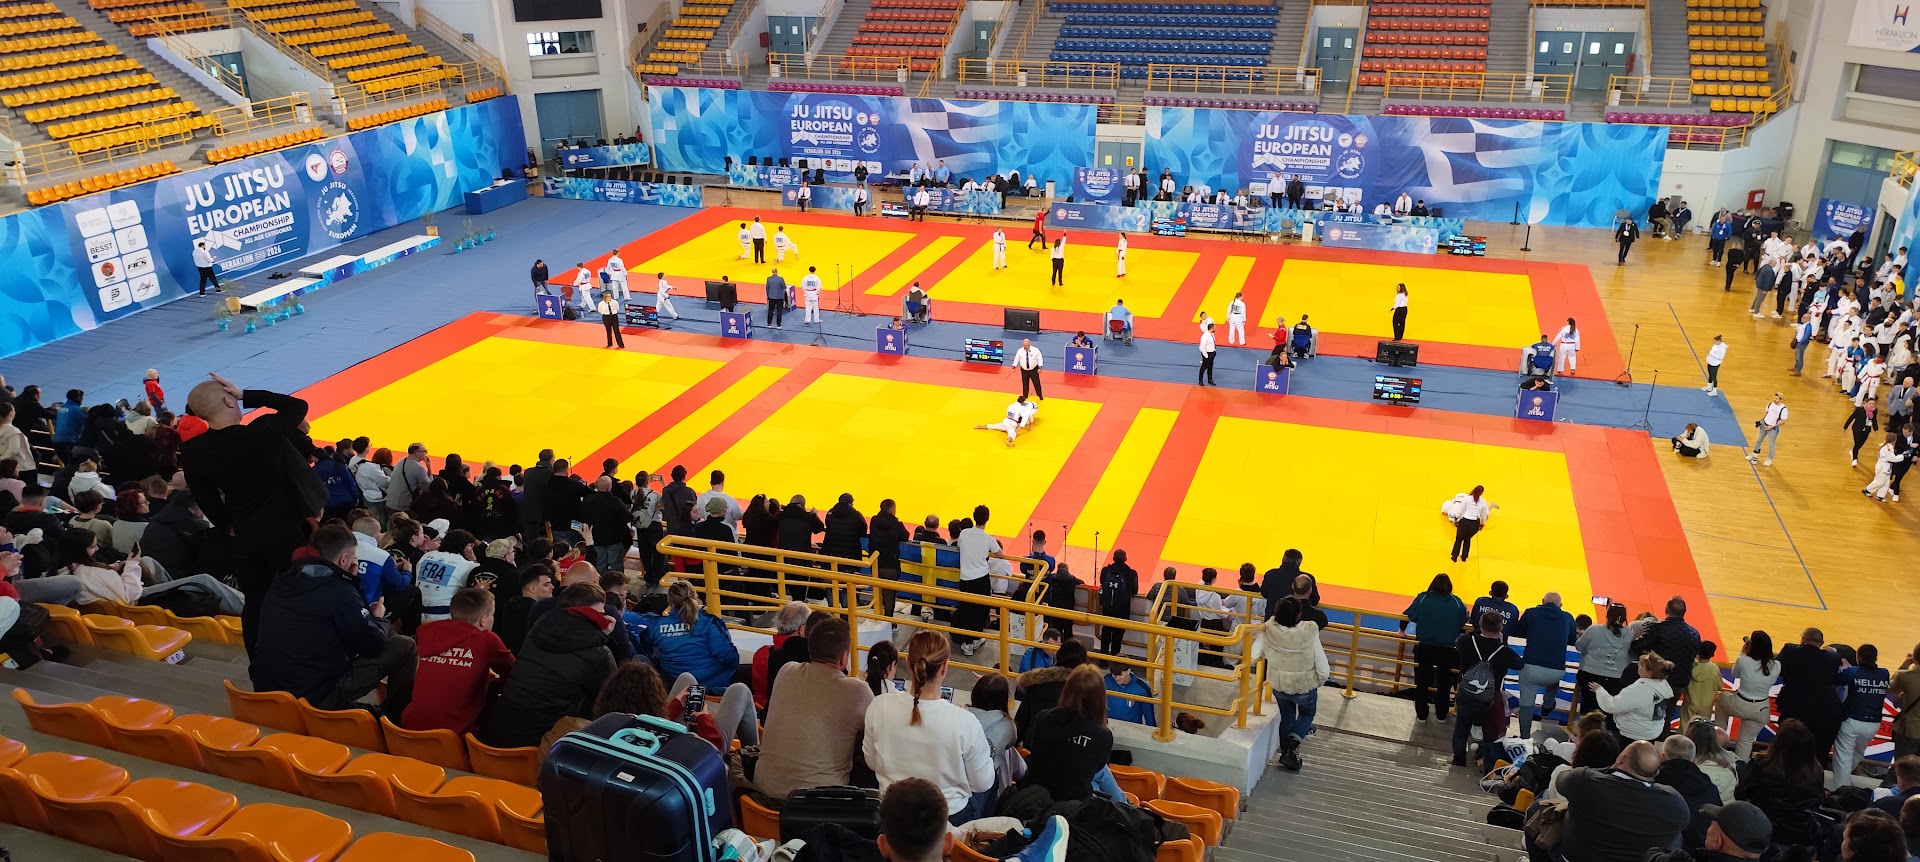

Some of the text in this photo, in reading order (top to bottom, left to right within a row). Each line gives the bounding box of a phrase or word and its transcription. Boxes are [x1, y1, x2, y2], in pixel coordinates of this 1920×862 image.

[791, 105, 852, 120] JU JITSU
[791, 120, 852, 132] EUROPEAN
[1256, 124, 1334, 142] JU JITSU
[1254, 141, 1332, 156] EUROPEAN
[185, 164, 284, 211] JU JITSU
[321, 181, 347, 195] JU JITSU
[187, 191, 291, 235] EUROPEAN
[1845, 207, 1863, 215] JITSU
[233, 216, 290, 238] CHAMPIONSHIP
[1137, 214, 1146, 226] 2
[265, 226, 293, 239] CATEGORIES
[328, 223, 358, 239] EUROPEAN
[1422, 235, 1432, 248] 3
[90, 243, 113, 255] BESST
[220, 245, 282, 271] HERAKLION 2026
[421, 562, 446, 580] FRA
[449, 658, 472, 667] TEAM
[1854, 678, 1888, 688] HELLAS
